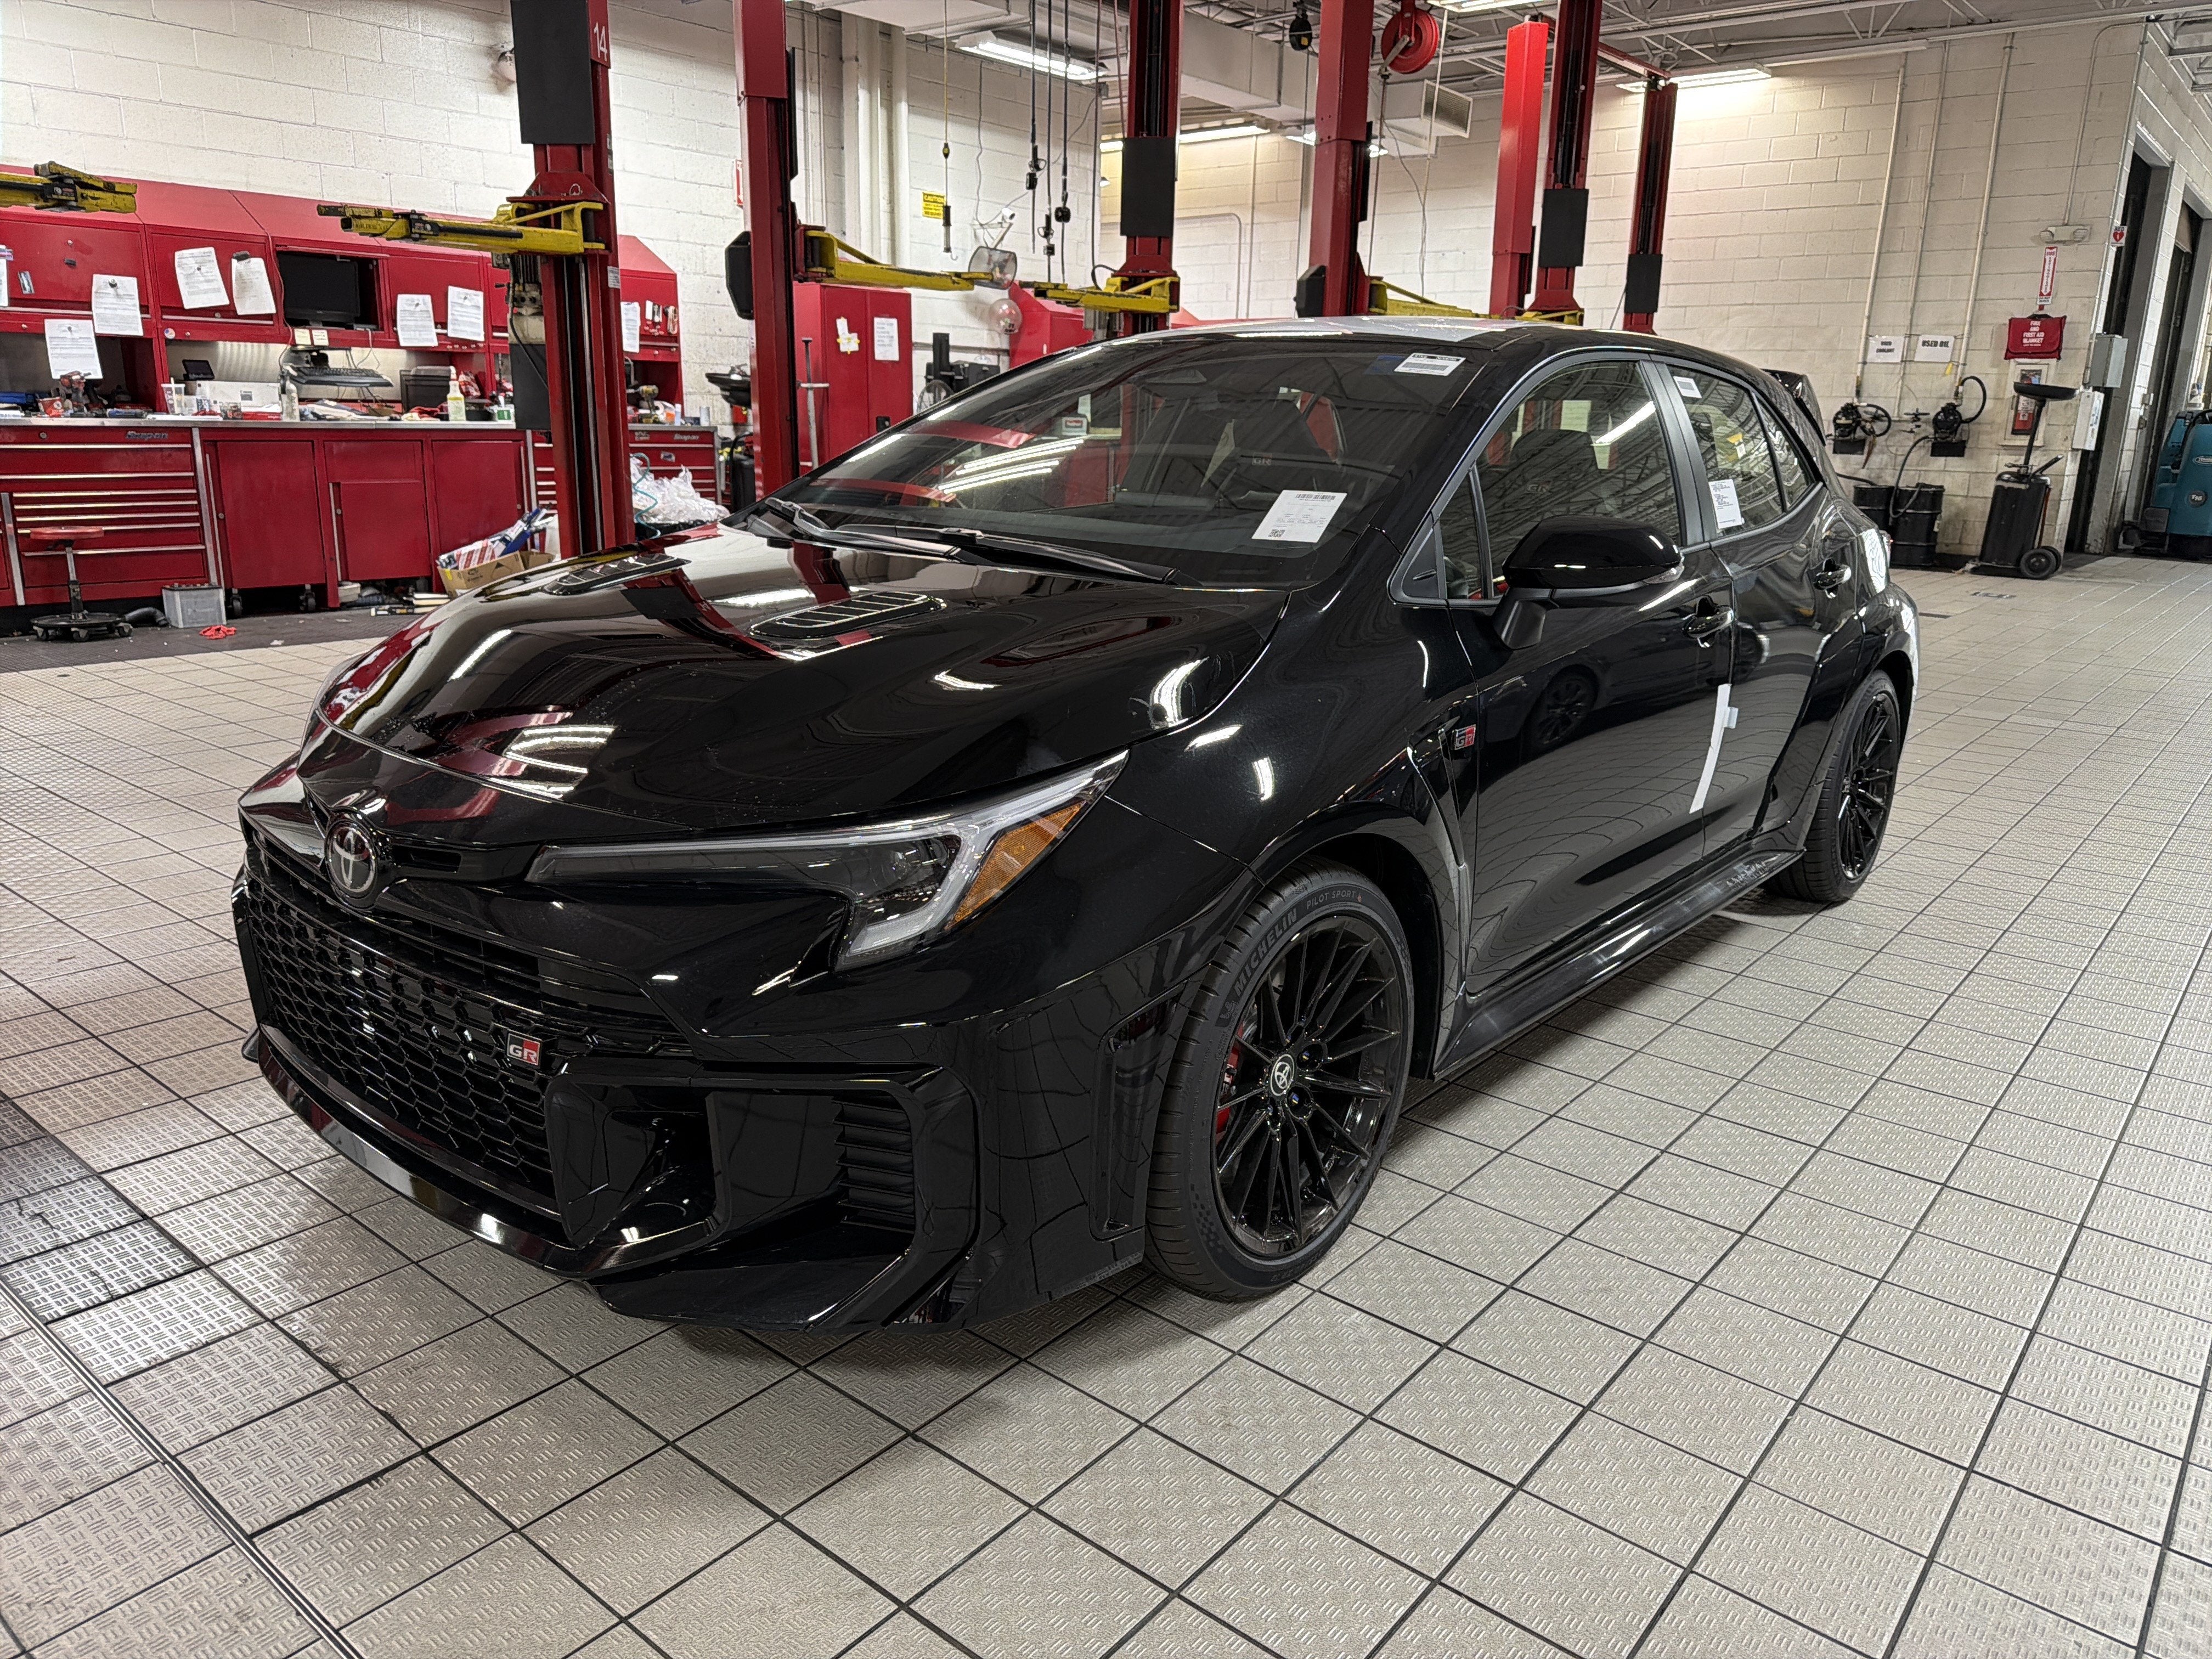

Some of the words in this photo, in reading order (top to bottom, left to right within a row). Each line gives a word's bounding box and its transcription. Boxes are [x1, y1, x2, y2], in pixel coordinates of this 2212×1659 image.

[594, 21, 607, 61] 14
[1253, 458, 1272, 466] GR
[1457, 734, 1474, 747] GR
[1234, 908, 1297, 997] MICHELIN
[1307, 893, 1329, 910] PILOT
[1331, 890, 1356, 899] SPORT
[509, 1044, 538, 1063] GR
